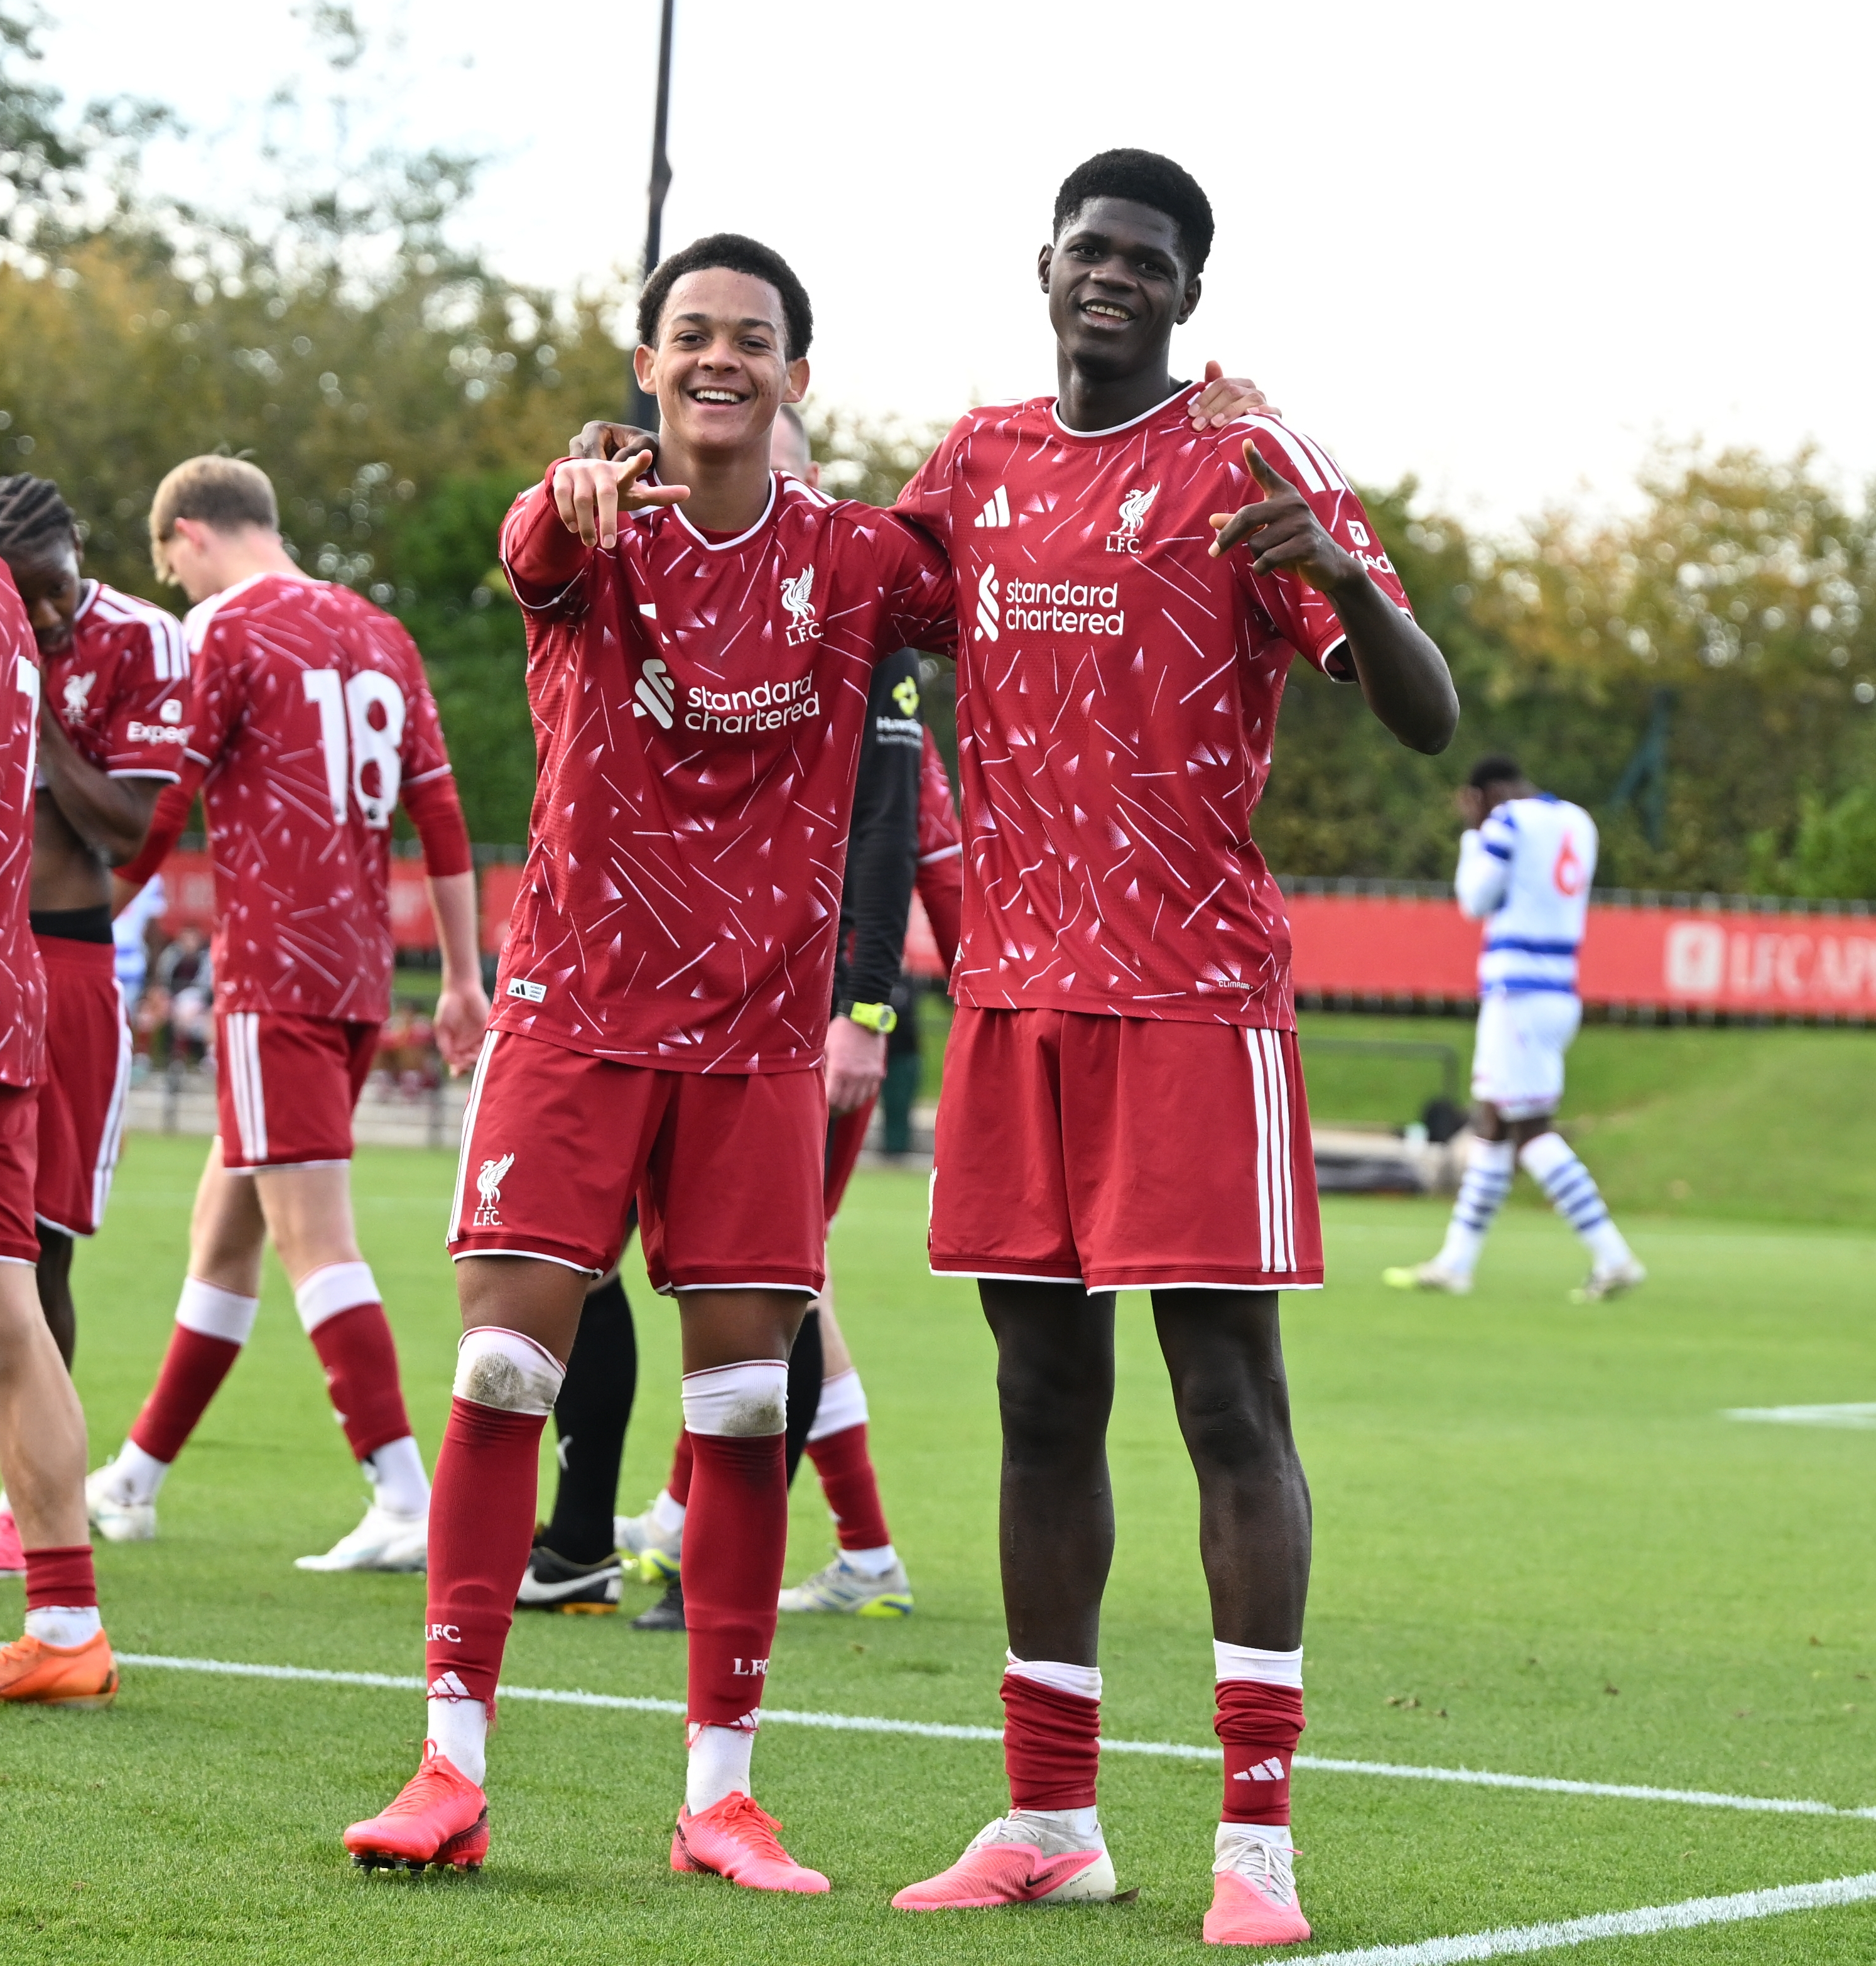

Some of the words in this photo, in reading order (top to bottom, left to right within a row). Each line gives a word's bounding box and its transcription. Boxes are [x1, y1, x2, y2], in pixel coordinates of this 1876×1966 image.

[1105, 536, 1142, 555] L.F.C.
[1006, 577, 1118, 608] standard
[785, 622, 824, 647] L.F.C.
[1006, 604, 1124, 635] chartered
[687, 669, 813, 711] standard
[685, 691, 820, 733] chartered
[301, 668, 406, 830] 18
[1552, 828, 1588, 897] 6
[1730, 932, 1814, 997] LFC
[472, 1210, 503, 1226] L.F.C.
[425, 1624, 461, 1643] LFC
